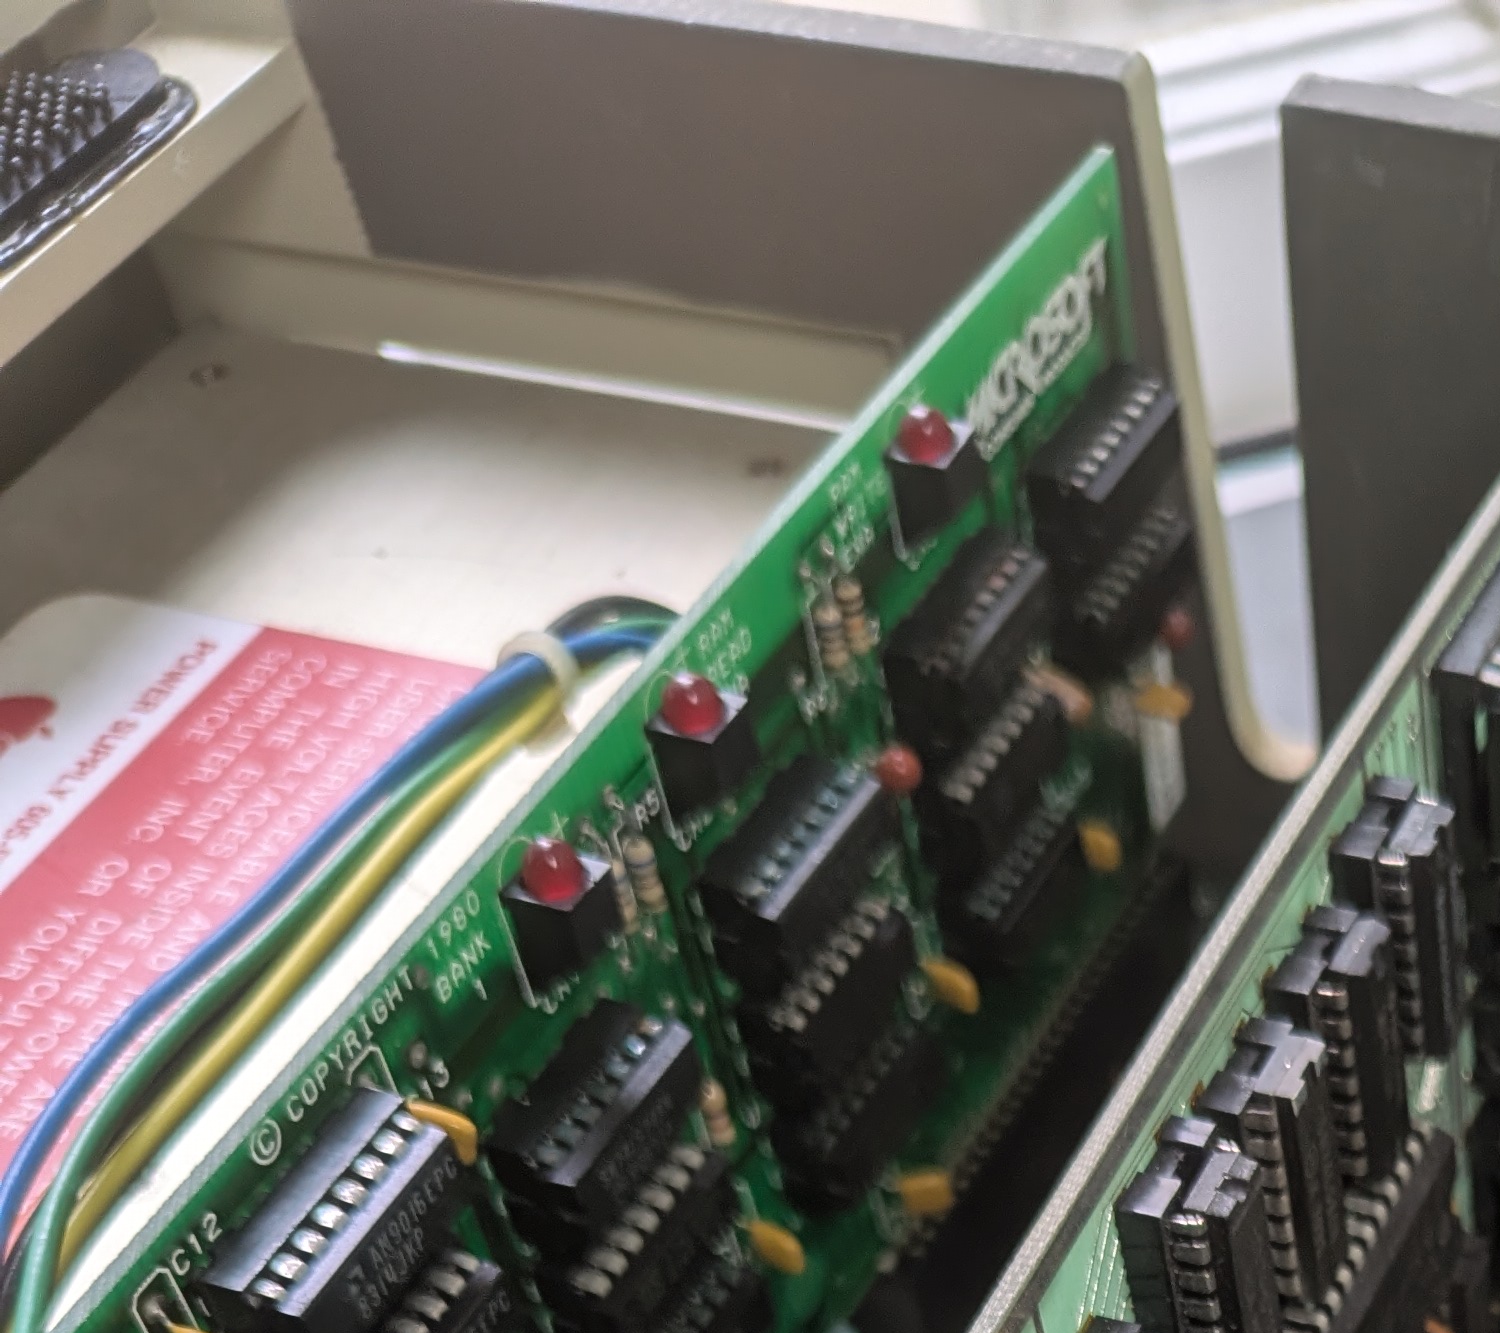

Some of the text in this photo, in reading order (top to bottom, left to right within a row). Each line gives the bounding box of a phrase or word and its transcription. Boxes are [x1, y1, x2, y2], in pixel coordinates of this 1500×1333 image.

[121, 651, 366, 903] IN THE EVENT OF
[72, 845, 133, 908] OR
[61, 941, 134, 1018] THE
[143, 905, 215, 980] AND
[427, 929, 498, 1005] BANK
[276, 887, 489, 1124] COPYRIGHT 1980
[466, 973, 497, 1003] 1
[164, 1210, 228, 1278] C12
